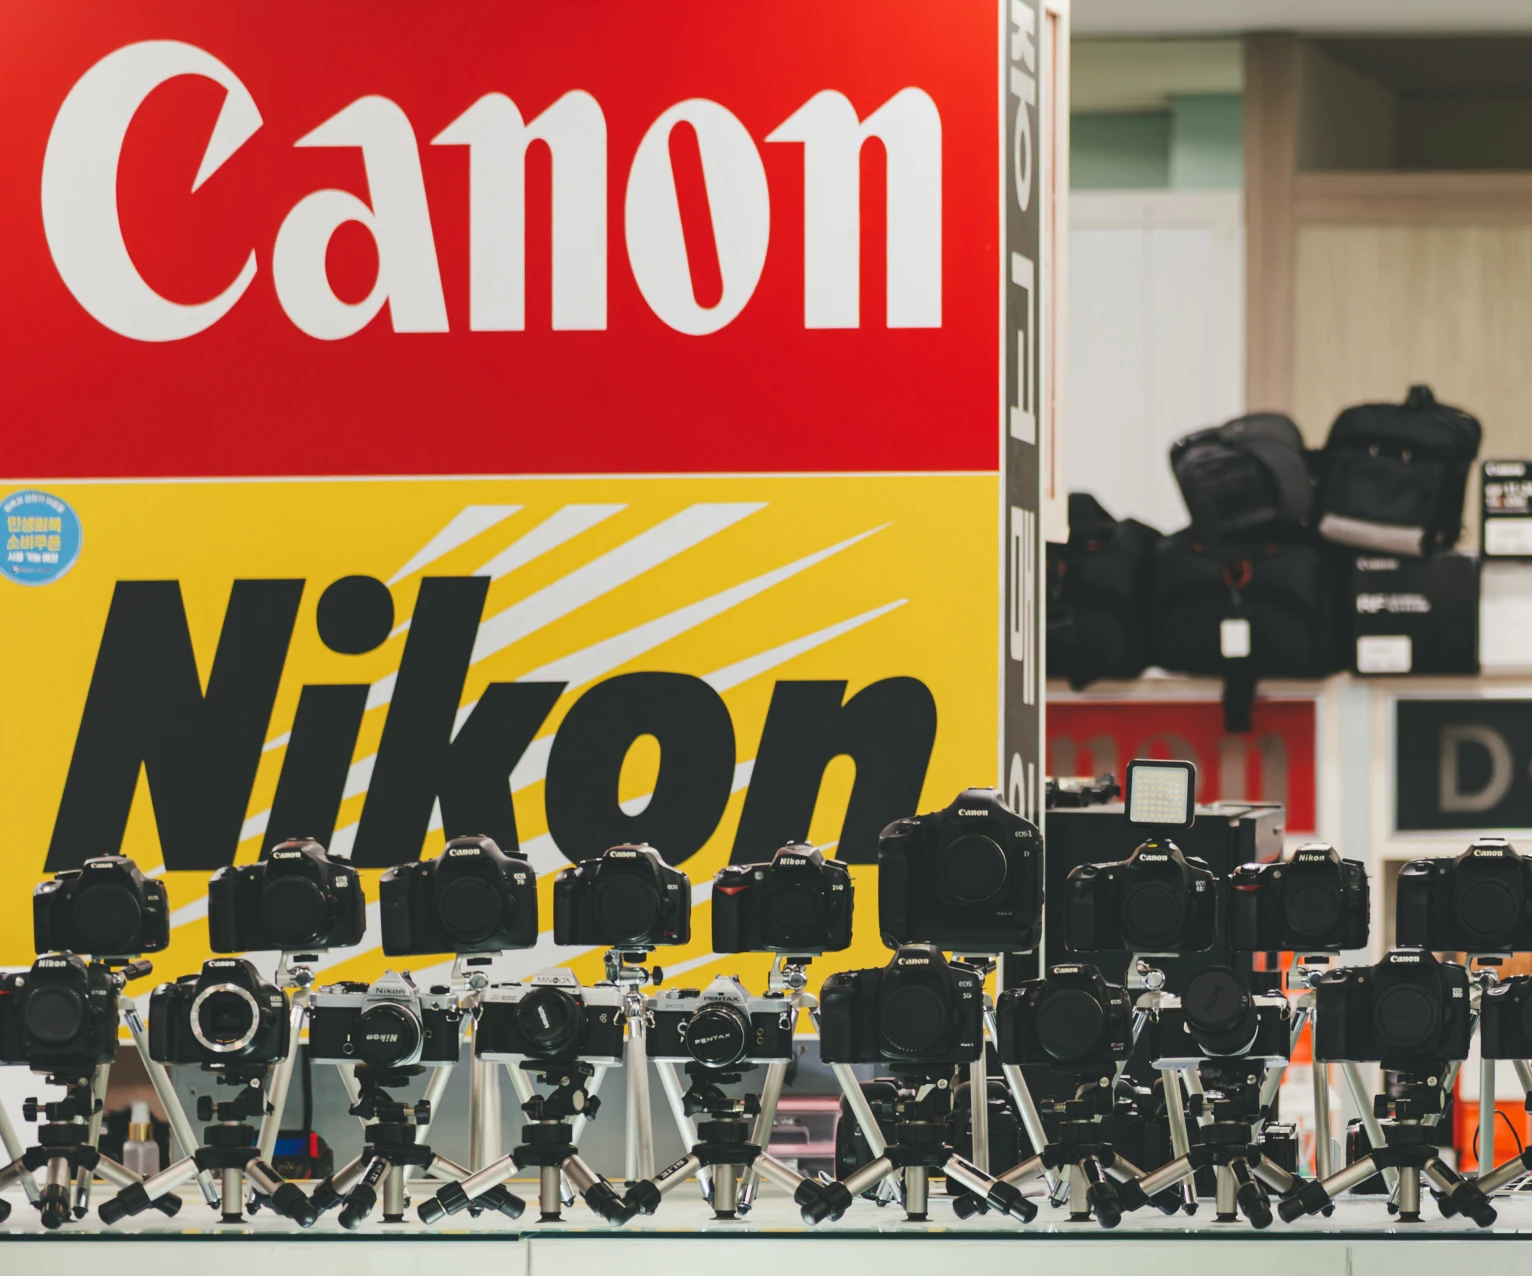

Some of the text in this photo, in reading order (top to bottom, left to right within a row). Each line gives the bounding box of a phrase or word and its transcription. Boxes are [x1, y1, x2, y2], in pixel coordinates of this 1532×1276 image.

[42, 41, 943, 341] Canon
[43, 576, 937, 873] Nikon
[208, 960, 236, 968] Canon
[1053, 966, 1078, 974] Canon
[366, 1034, 398, 1042] Nikon
[695, 1033, 730, 1044] PENTAX
